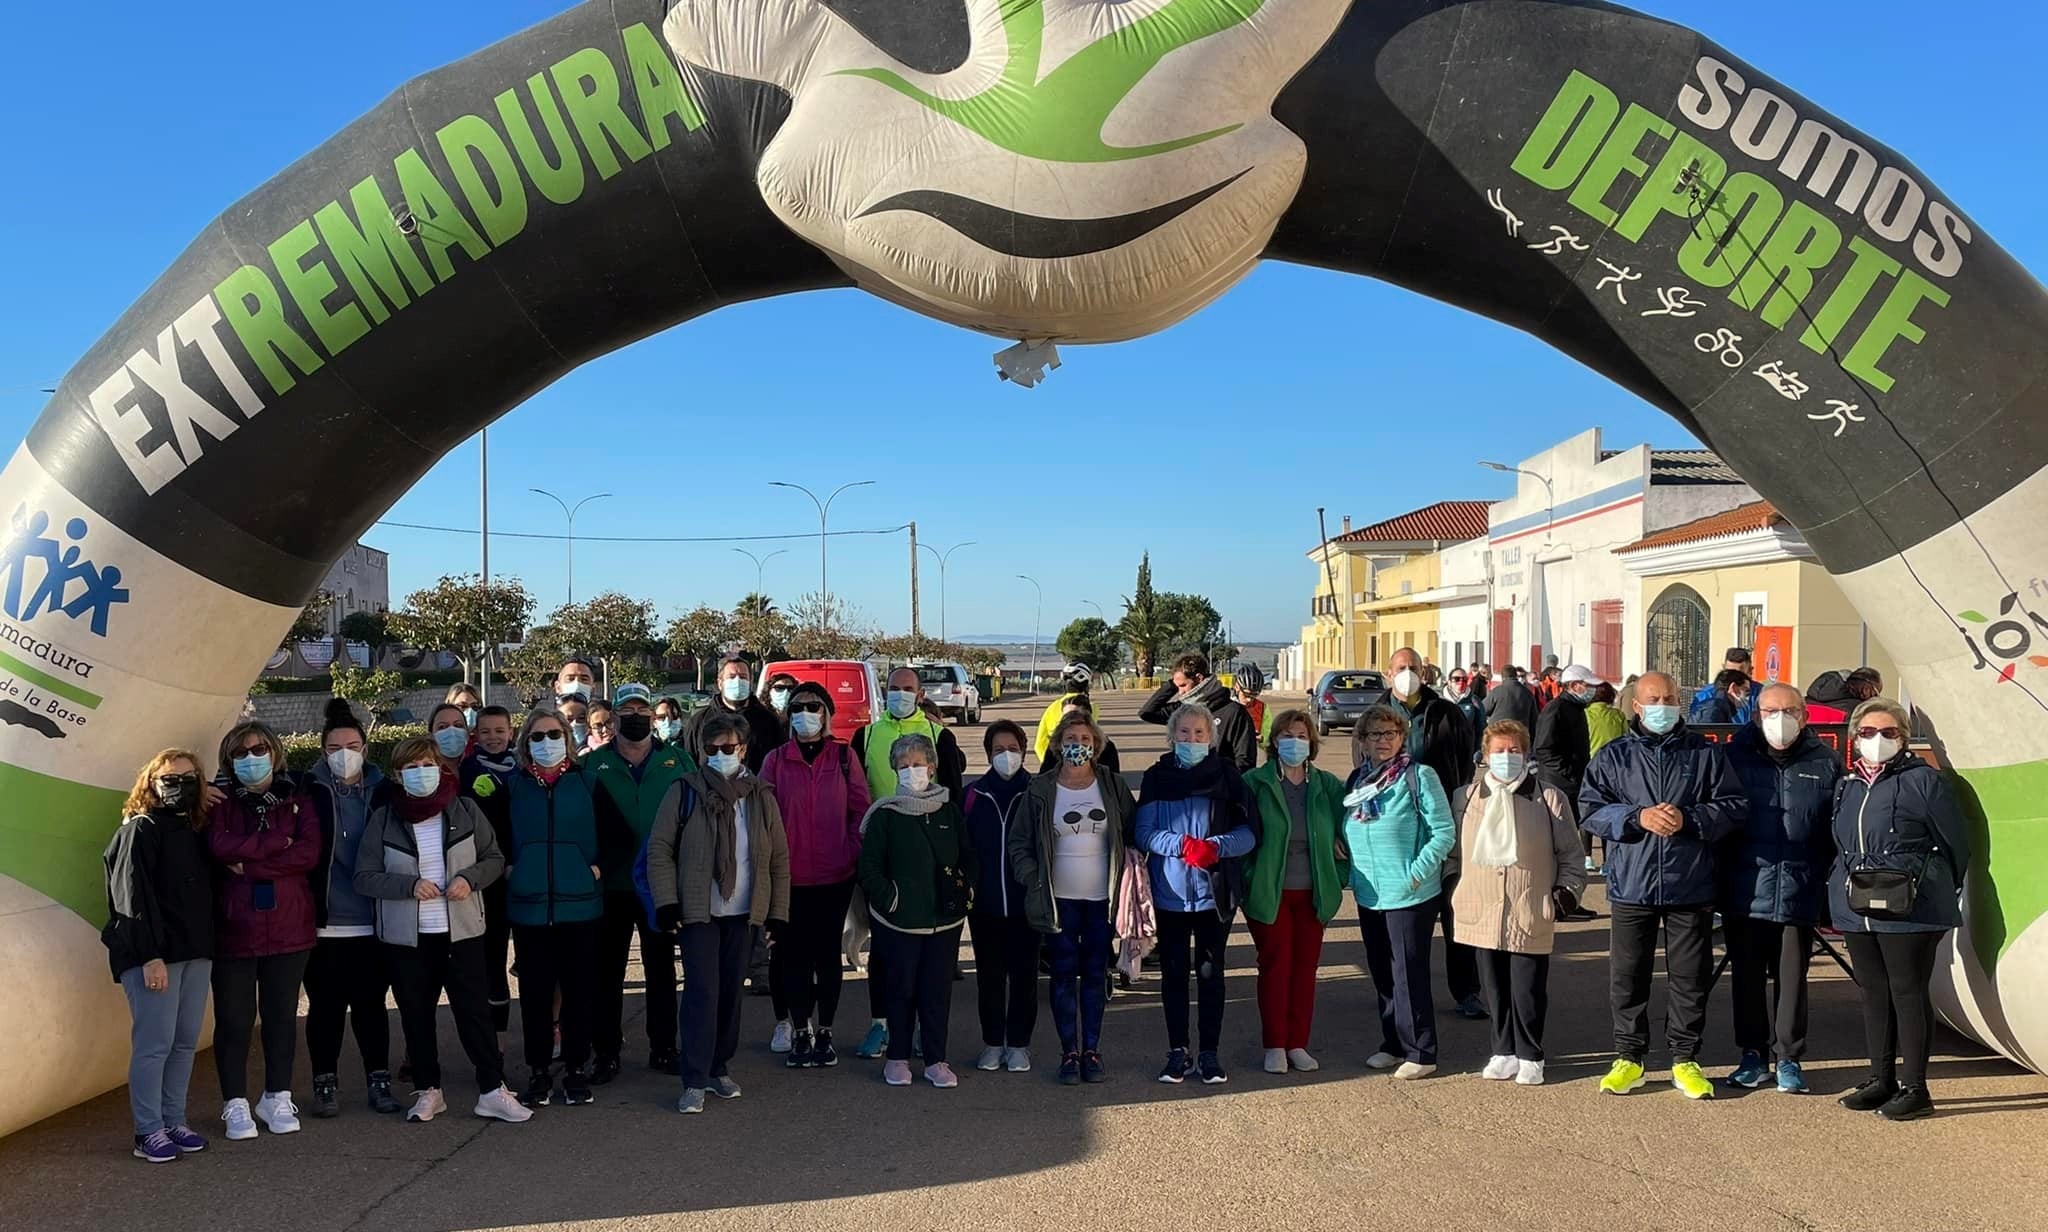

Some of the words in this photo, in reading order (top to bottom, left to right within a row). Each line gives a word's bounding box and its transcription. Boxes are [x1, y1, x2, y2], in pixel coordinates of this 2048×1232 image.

[88, 22, 708, 497] EXTREMADURA
[1510, 69, 1952, 393] DEPORTE
[1677, 56, 1972, 278] SOMOS
[0, 622, 94, 678] madura
[23, 688, 41, 707] la
[46, 699, 87, 726] Base
